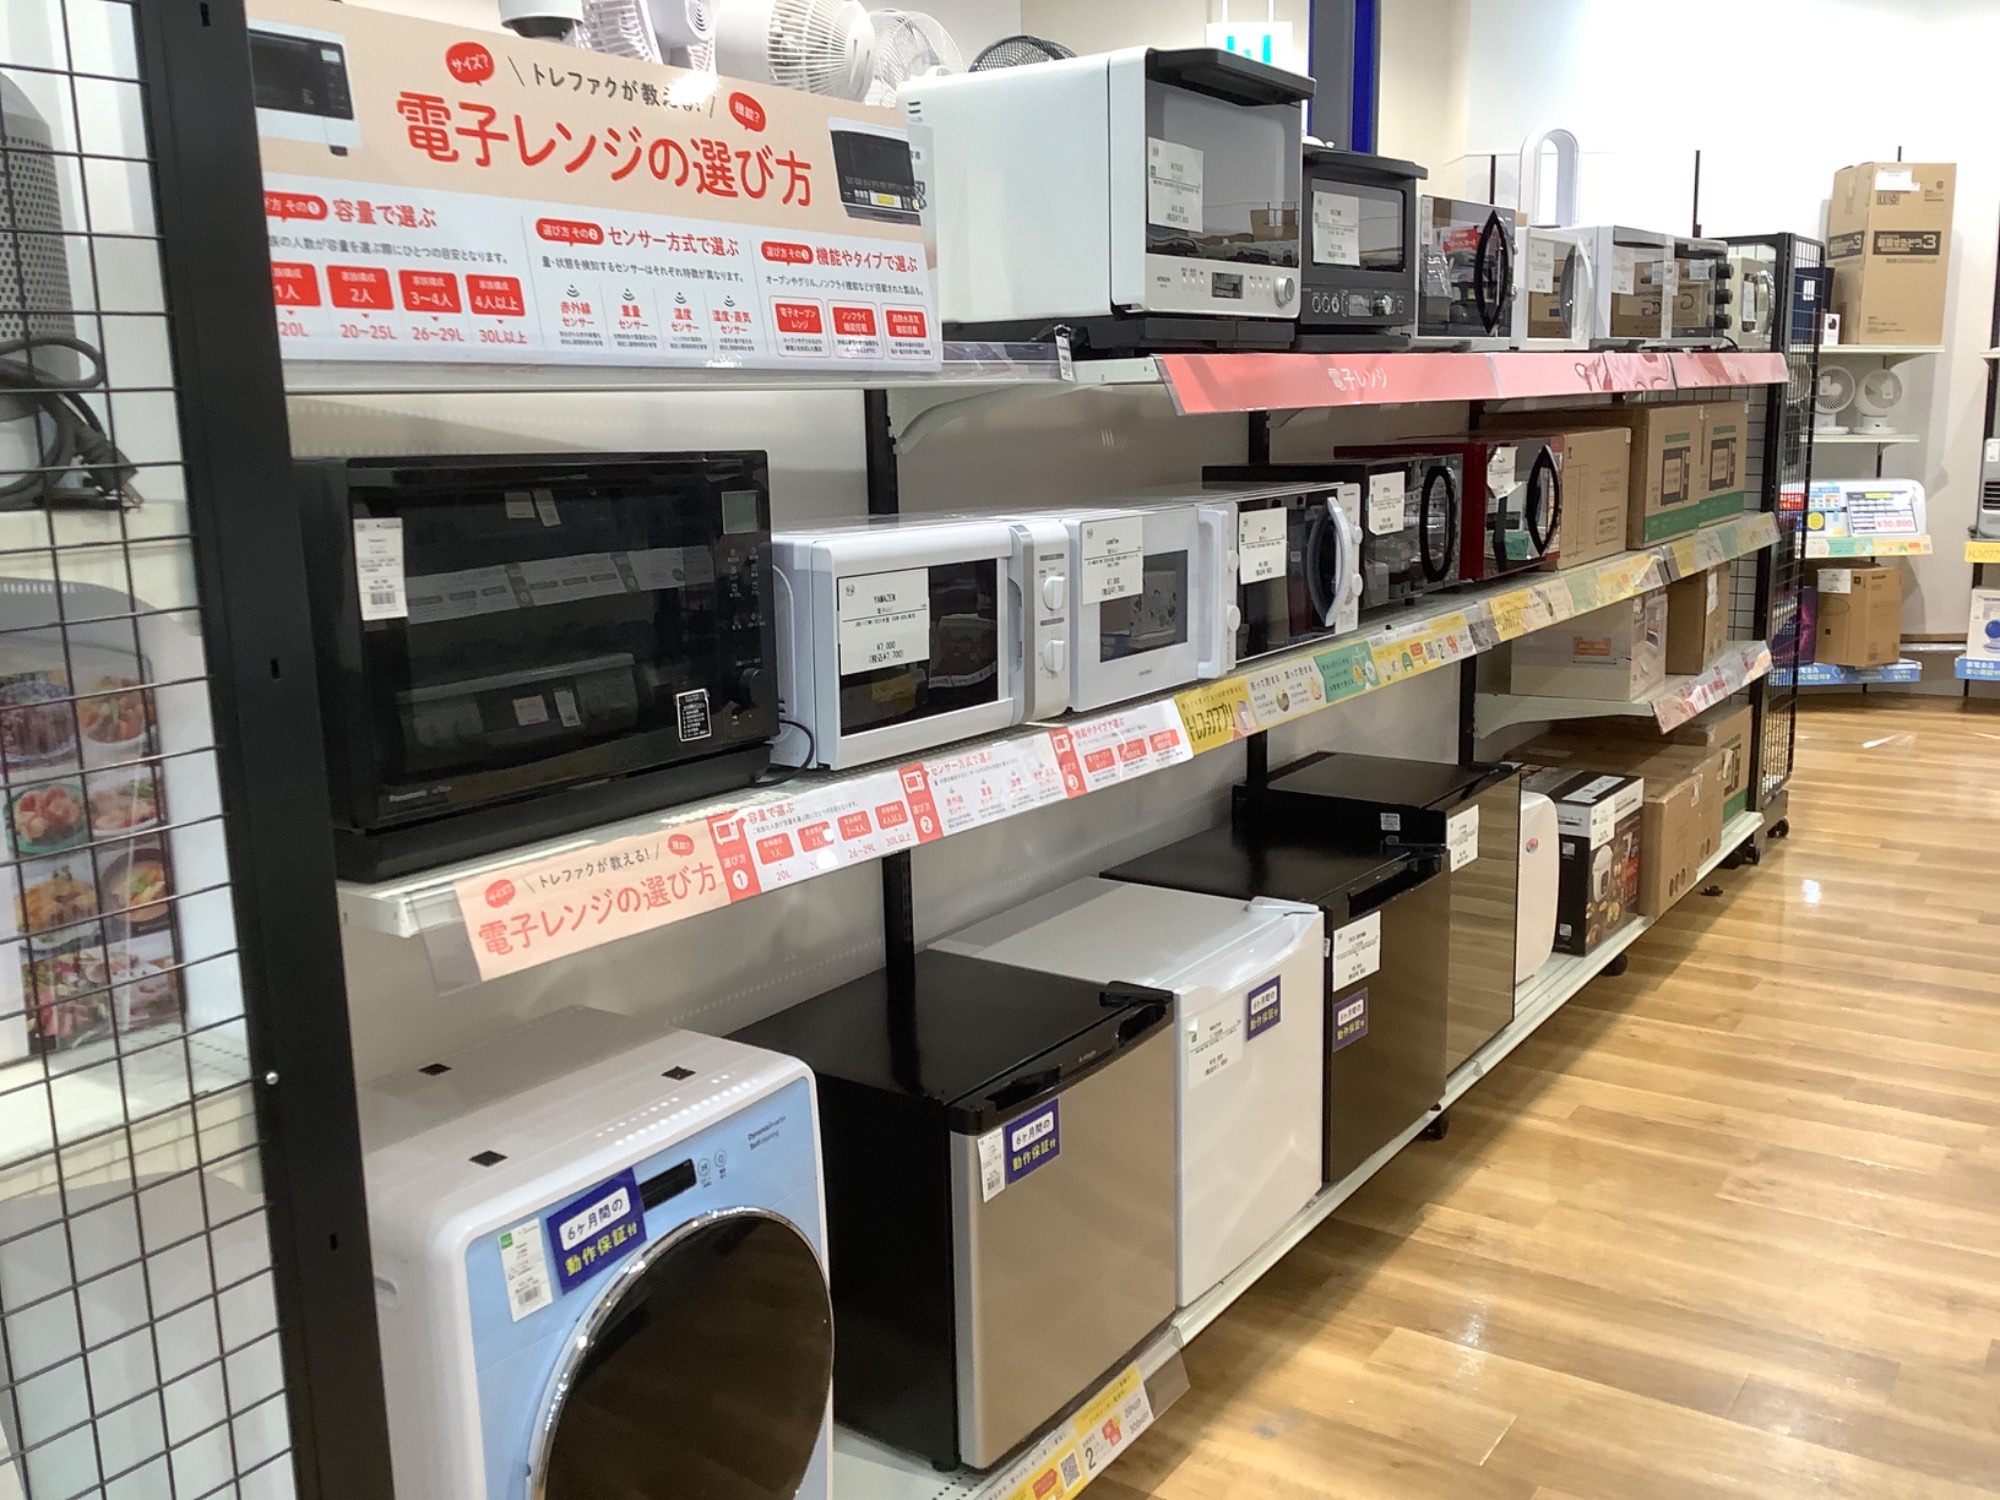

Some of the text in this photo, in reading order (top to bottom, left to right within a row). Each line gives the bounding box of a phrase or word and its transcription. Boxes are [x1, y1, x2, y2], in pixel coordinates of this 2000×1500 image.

[450, 51, 489, 70] サイズ?
[396, 91, 812, 207] 電子レンジの選び方
[332, 199, 438, 228] 容量で選ぶ
[542, 223, 569, 237] 選び方
[608, 226, 740, 257] センサー方式で選ぶ
[765, 245, 788, 258] 選び方
[815, 246, 919, 273] 機能やタイプで選ぶ
[275, 285, 300, 300] 1人
[351, 288, 375, 303] 2人
[410, 291, 454, 307] 3～4人
[474, 295, 520, 312] 4人以上
[560, 301, 593, 315] 赤外線
[621, 304, 642, 318] 重量
[673, 307, 694, 321] 温度
[841, 310, 867, 321] ノンフライ
[561, 316, 595, 328] センサー
[617, 319, 650, 331] センサー
[670, 321, 700, 333] センサー
[720, 324, 748, 335] センサー
[790, 319, 809, 330] レンジ
[340, 324, 398, 340] 20～25L
[412, 327, 466, 342] 26～29L
[480, 329, 528, 344] 30L以上
[1327, 367, 1388, 391] 電子レンジ
[1074, 717, 1126, 740] 機能やタイプで選ぶ
[930, 752, 994, 777] センサー方式で選ぶ
[747, 802, 796, 823] 容量で選ぶ
[912, 803, 931, 816] 選び方
[721, 854, 748, 870] 選び方
[477, 862, 718, 956] 電子レンジの選び方
[1012, 1138, 1057, 1172] 動作保証付
[564, 1221, 639, 1277] 動作保証付
